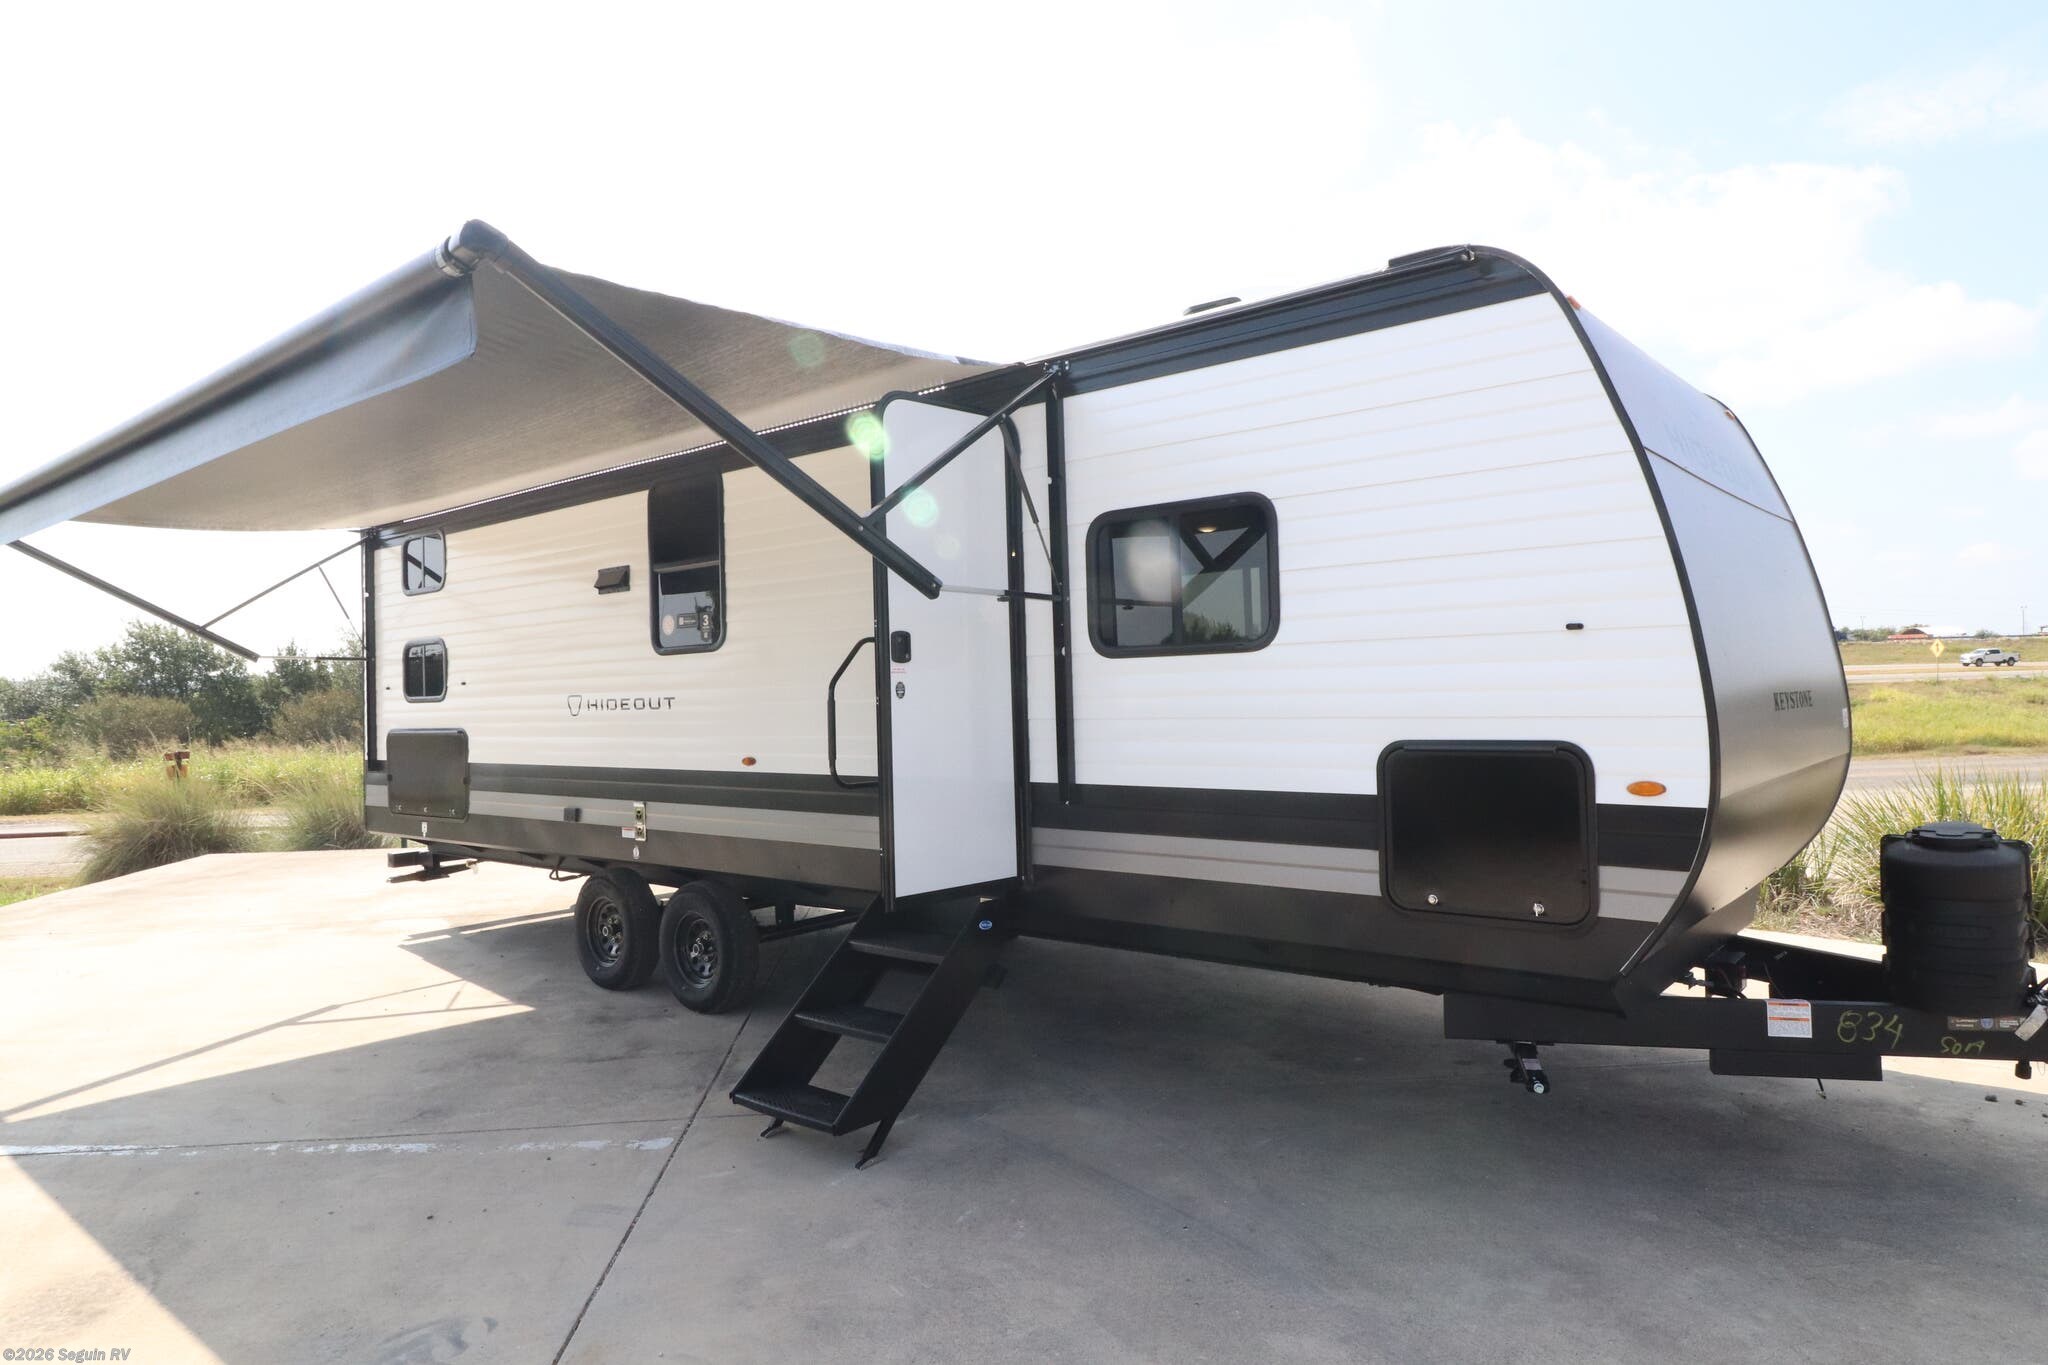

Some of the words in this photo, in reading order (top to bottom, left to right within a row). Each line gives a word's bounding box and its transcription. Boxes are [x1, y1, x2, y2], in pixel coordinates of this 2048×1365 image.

[702, 614, 709, 626] 3
[587, 697, 676, 711] HIDEOUT
[1773, 690, 1813, 711] KEYSTONE
